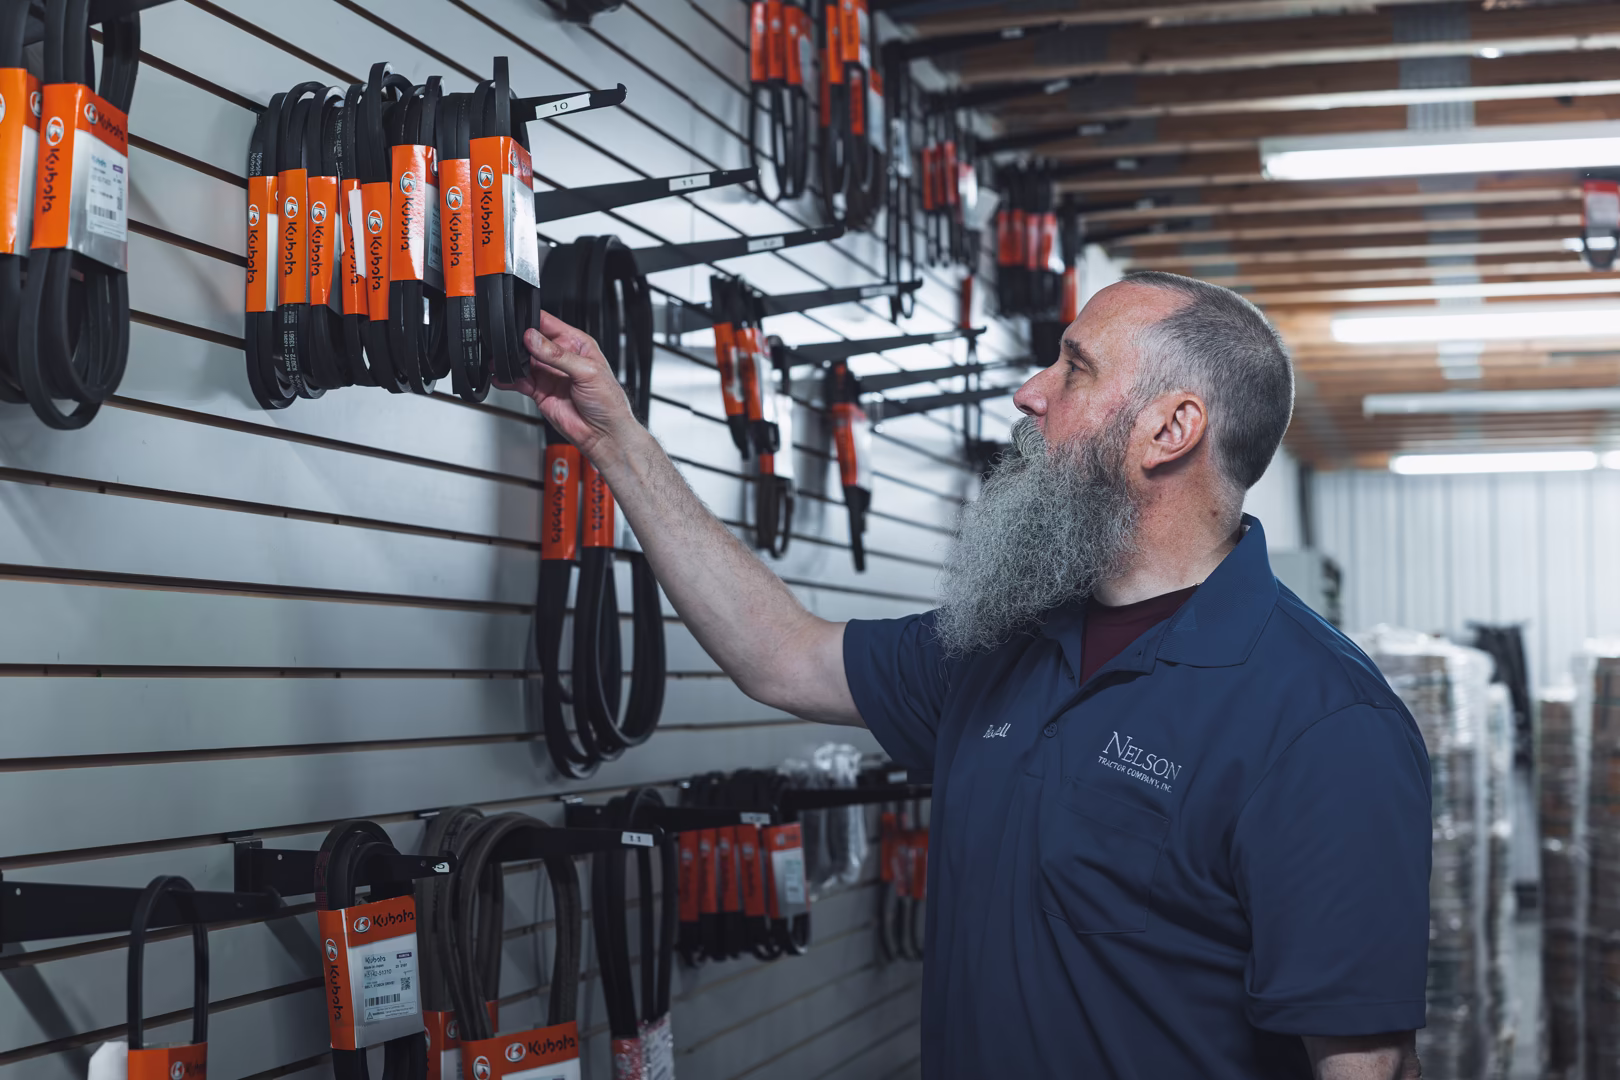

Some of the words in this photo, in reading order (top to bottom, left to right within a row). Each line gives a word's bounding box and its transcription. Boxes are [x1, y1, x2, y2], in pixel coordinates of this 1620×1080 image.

[553, 102, 568, 111] 10
[41, 148, 60, 214] Kubota
[400, 197, 415, 252] Kubota
[447, 212, 463, 269] Kubota
[481, 190, 496, 248] Kubota
[247, 229, 259, 284] Kubota
[284, 221, 298, 278] Kubota
[311, 225, 325, 277] Kubota
[369, 236, 384, 292] Kubota
[551, 486, 566, 544] Kubota
[592, 473, 605, 530] Kubota
[1098, 756, 1126, 773] TRACTOR
[1126, 768, 1160, 789] COMPANY,
[1102, 731, 1182, 780] NELSON
[372, 908, 415, 929] Kubota
[365, 956, 386, 964] Kubota
[329, 964, 344, 1022] Kubota
[528, 1034, 576, 1057] Kubota
